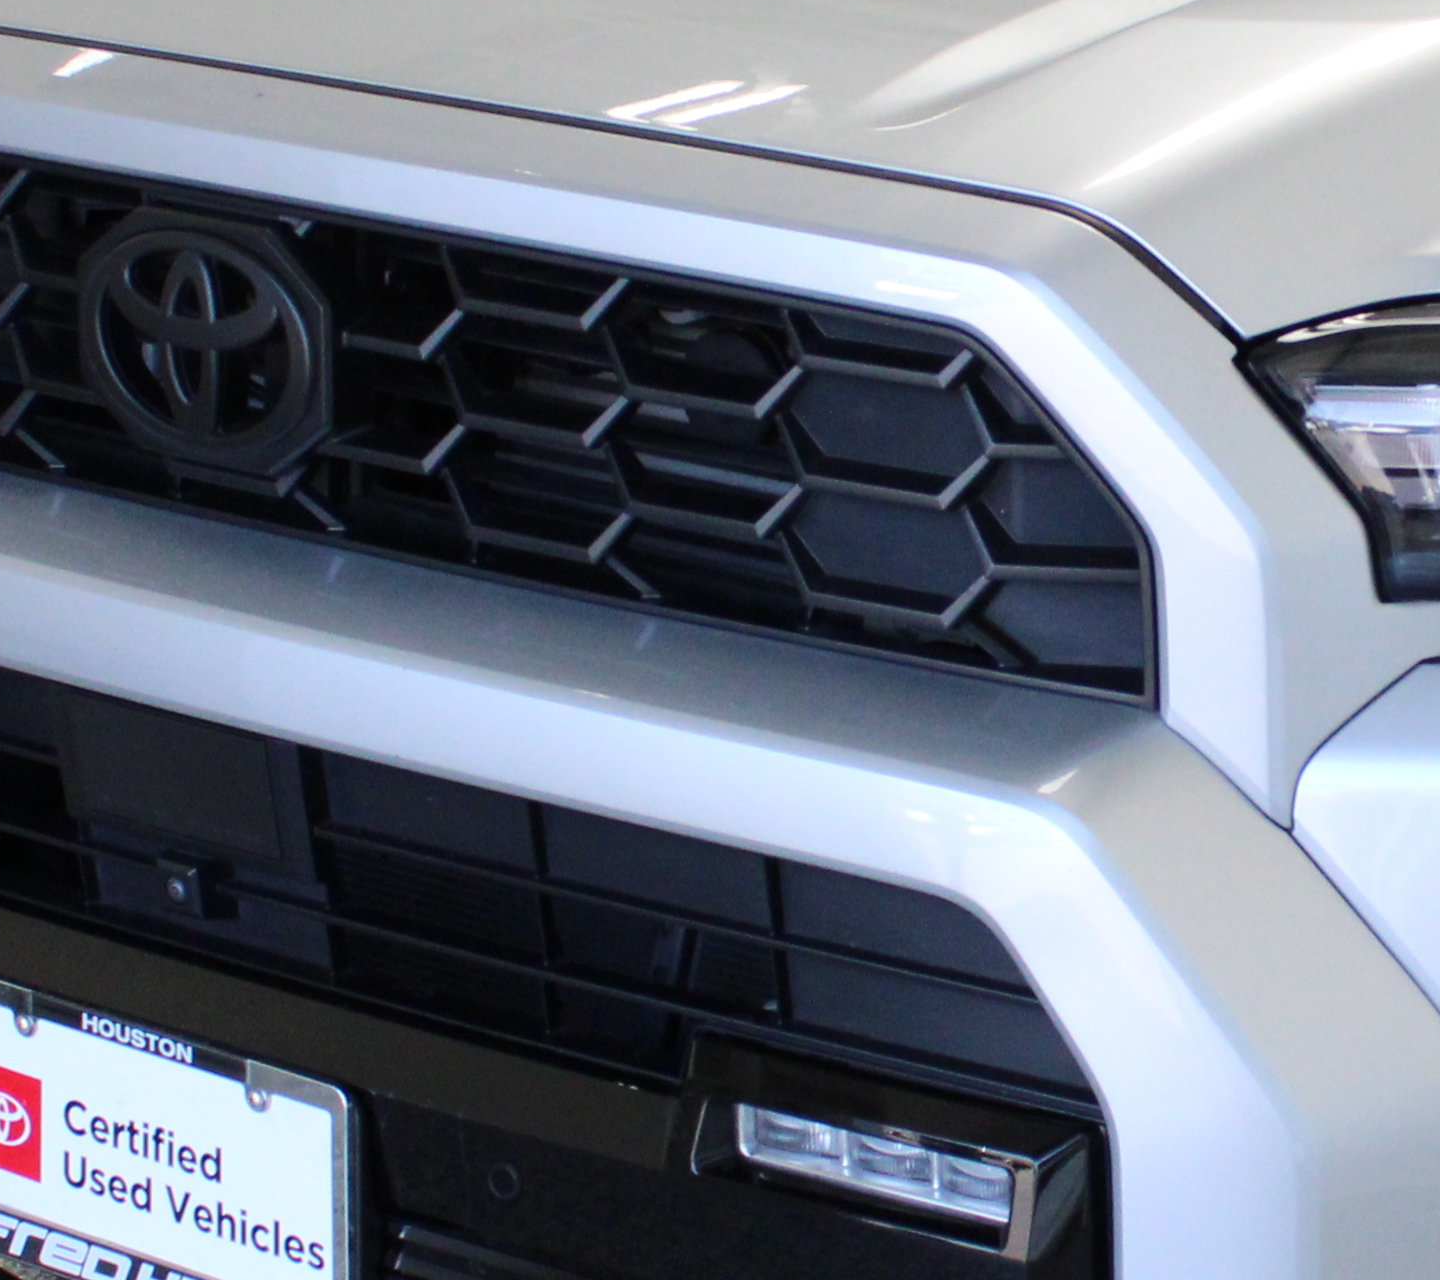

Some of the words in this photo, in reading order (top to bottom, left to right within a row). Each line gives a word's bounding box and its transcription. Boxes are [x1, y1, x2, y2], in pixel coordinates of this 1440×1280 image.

[81, 1012, 193, 1064] HOUSTON
[63, 1099, 222, 1183] Certified
[63, 1150, 152, 1212] Used
[165, 1184, 326, 1271] Vehicles
